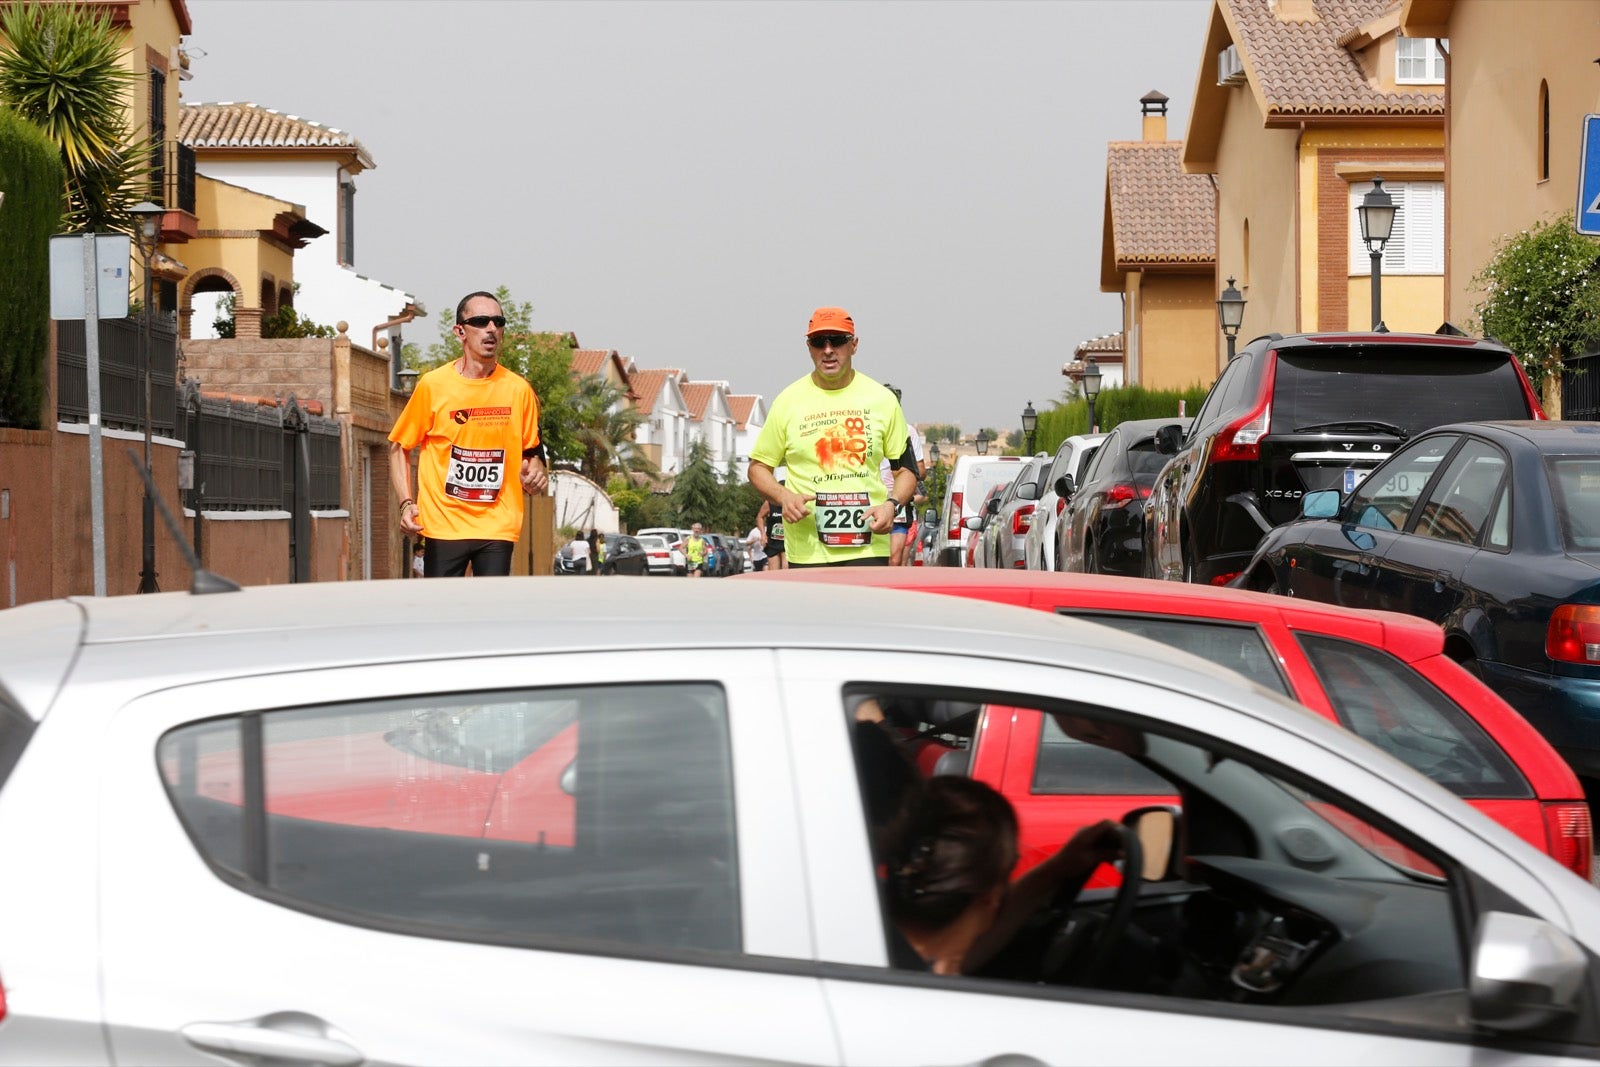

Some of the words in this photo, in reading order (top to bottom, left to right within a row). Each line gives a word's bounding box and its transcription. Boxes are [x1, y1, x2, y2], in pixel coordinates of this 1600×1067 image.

[804, 411, 827, 422] GRAN
[830, 409, 862, 417] PREMIO
[863, 408, 871, 421] FE
[811, 418, 838, 428] FONDO
[845, 417, 867, 466] 2018
[865, 424, 873, 457] SANTA
[454, 463, 499, 483] 3005
[812, 475, 823, 485] La
[824, 470, 870, 482] Hispanidad
[1264, 489, 1303, 498] XC60
[823, 508, 866, 529] 226
